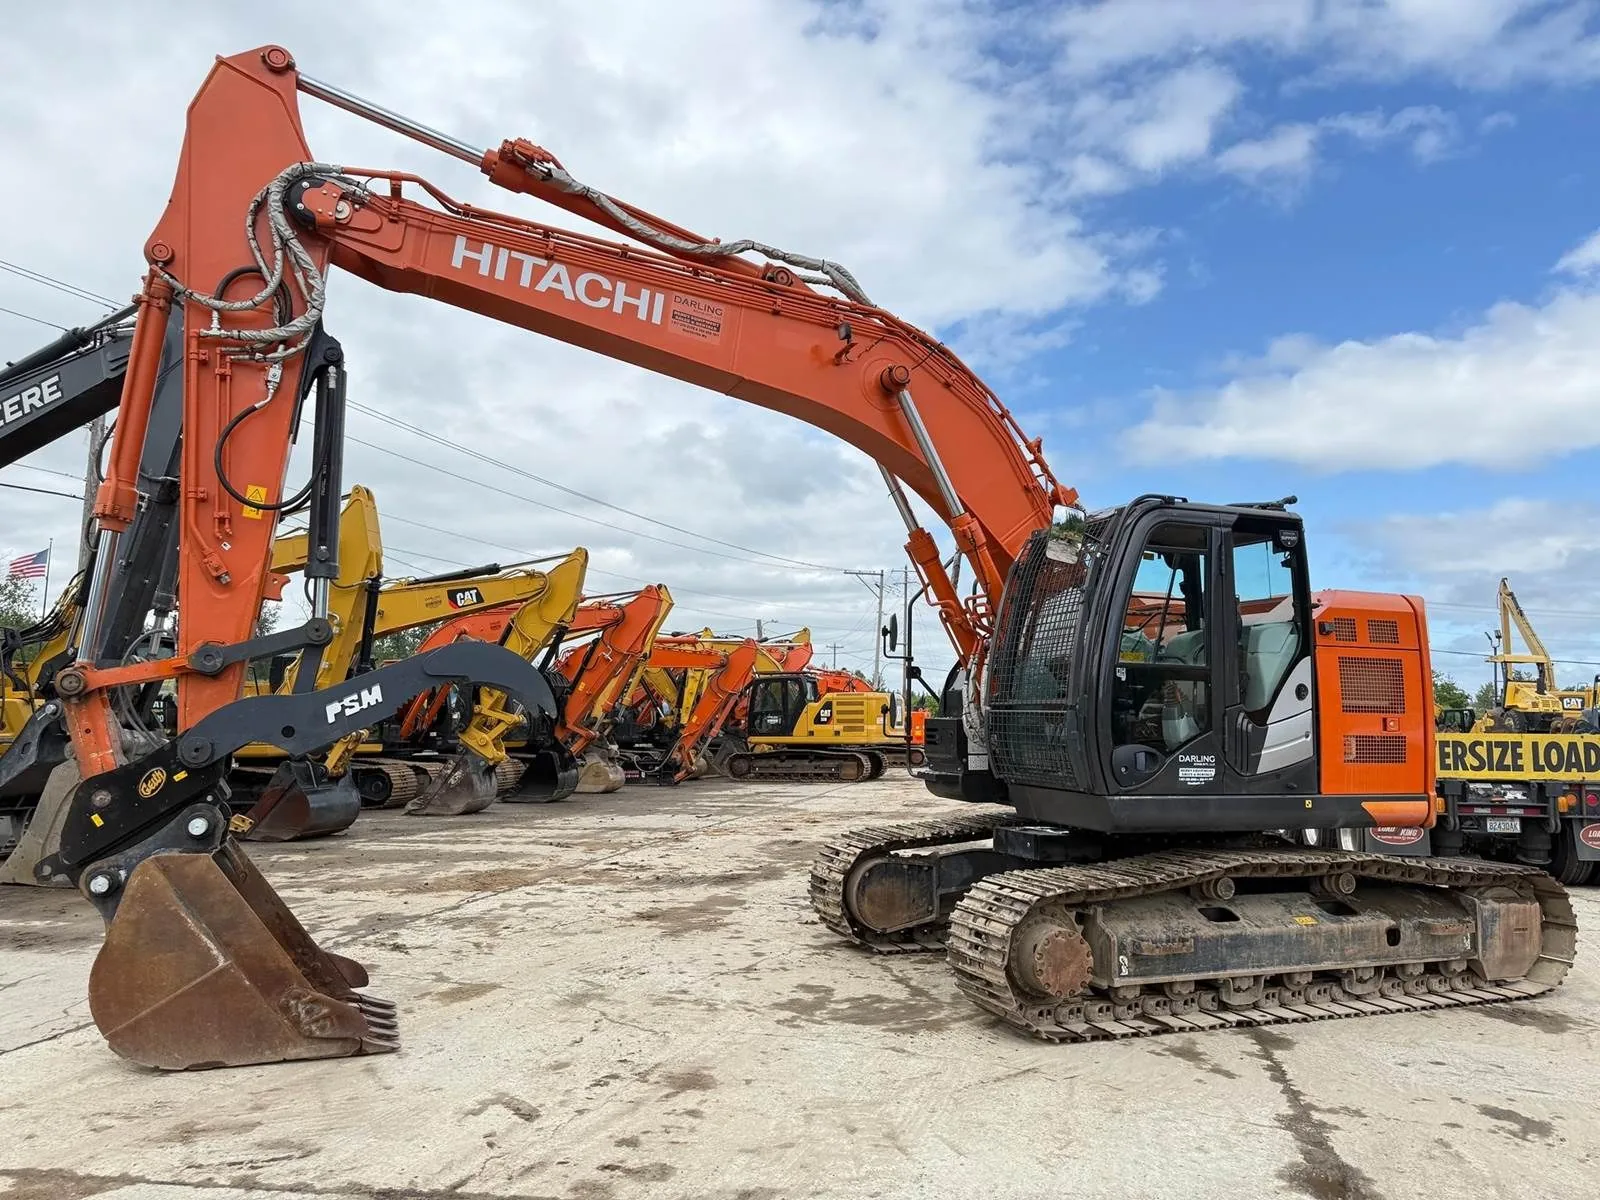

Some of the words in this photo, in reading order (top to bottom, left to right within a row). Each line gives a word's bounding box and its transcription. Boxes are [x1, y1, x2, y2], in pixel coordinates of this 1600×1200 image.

[451, 235, 665, 325] HITACHI
[674, 295, 723, 316] DARLING
[0, 375, 62, 427] ERE
[456, 589, 478, 607] CAT
[325, 682, 383, 724] PSM
[1563, 697, 1583, 709] CAT
[820, 709, 831, 717] CAT
[1178, 754, 1216, 763] DARLING
[1438, 740, 1524, 771] ERSIZE
[1532, 741, 1600, 773] LOAD
[1400, 828, 1418, 836] KING
